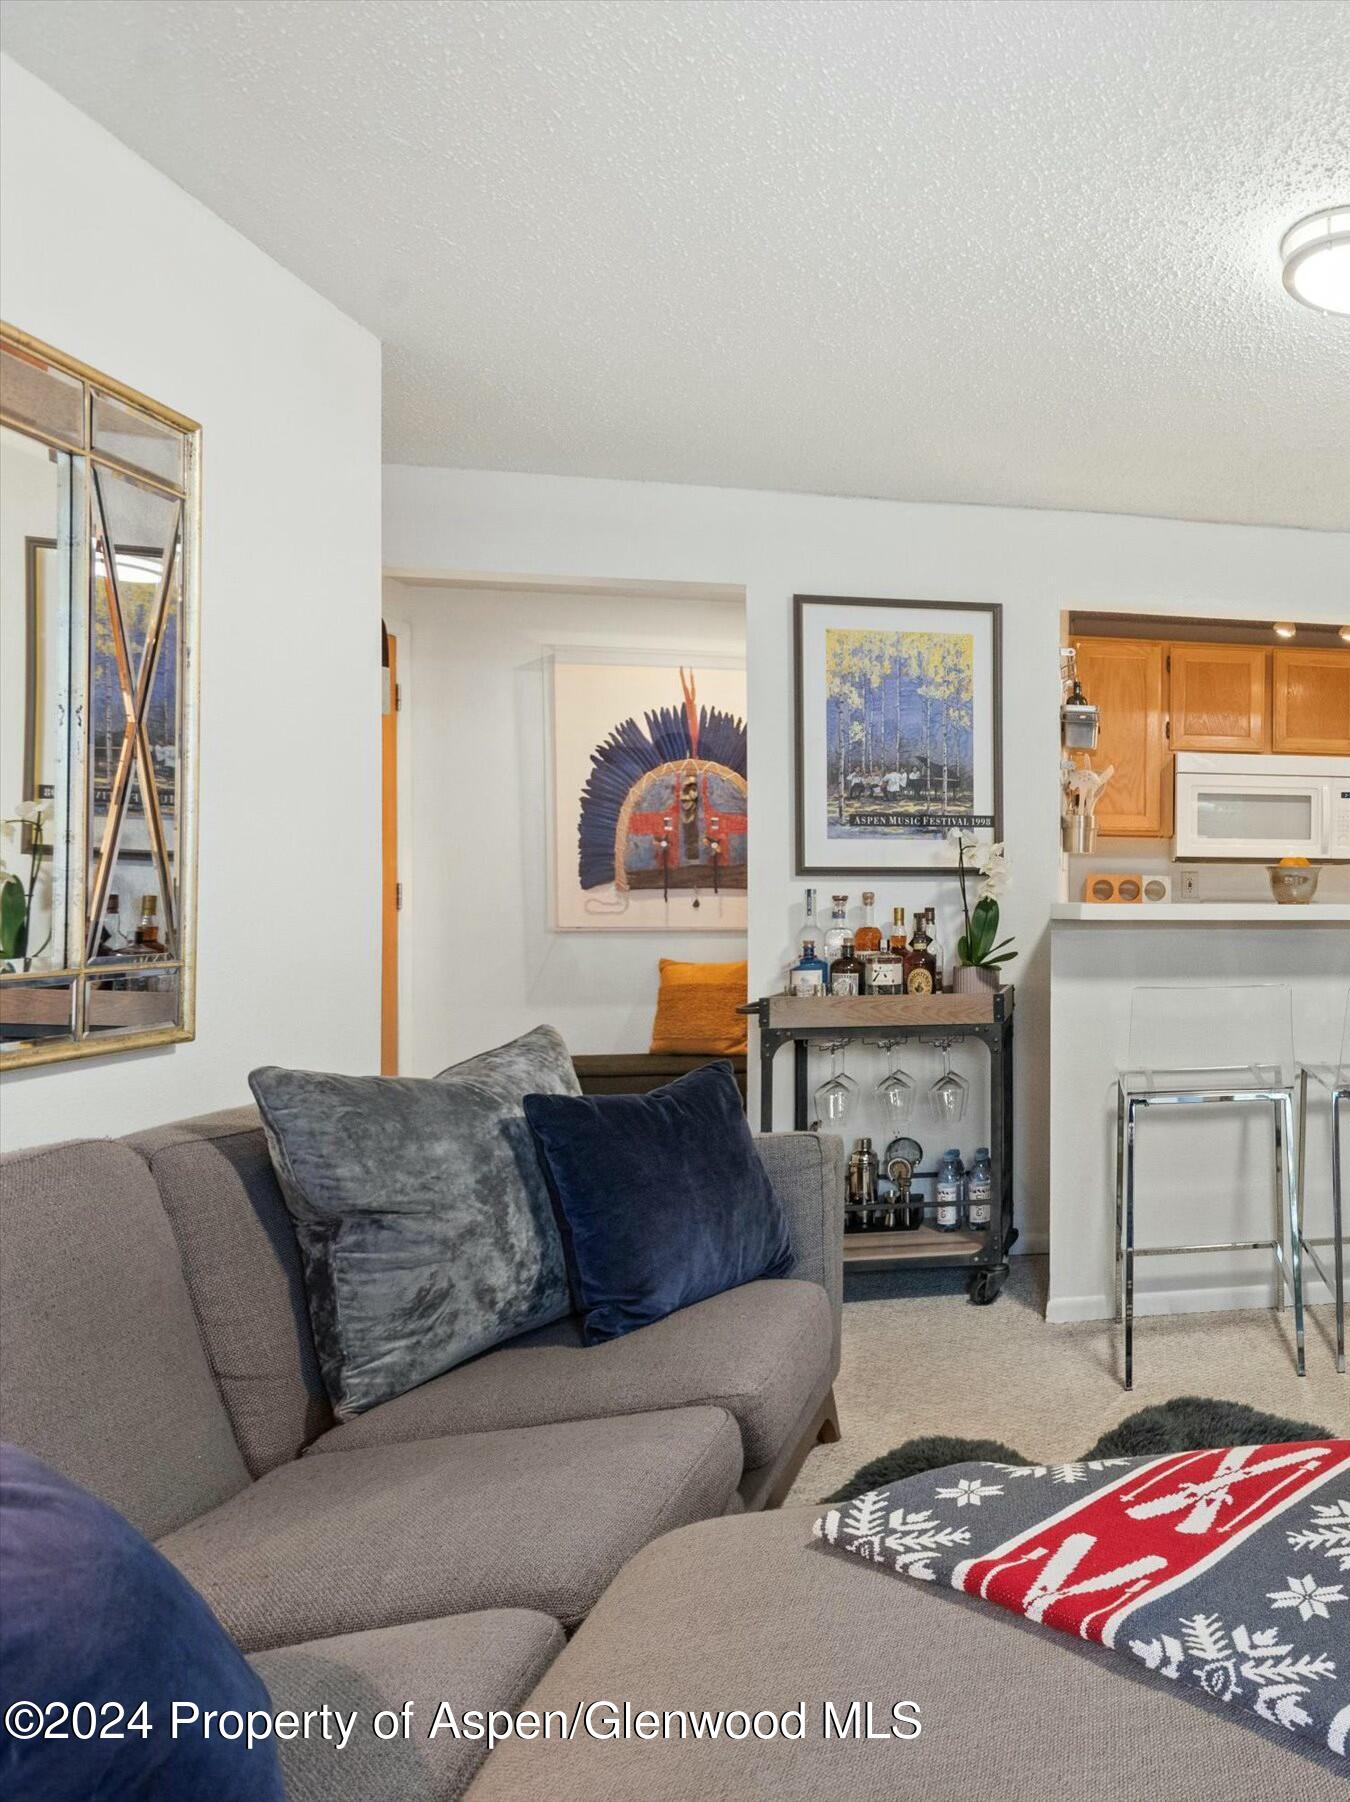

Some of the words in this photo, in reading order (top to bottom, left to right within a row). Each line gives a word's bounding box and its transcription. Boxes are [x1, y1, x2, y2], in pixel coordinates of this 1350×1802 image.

[854, 815, 886, 825] ASPEN
[889, 815, 921, 826] MUSIC
[923, 816, 969, 826] FESTIVAL
[971, 817, 991, 826] 1998
